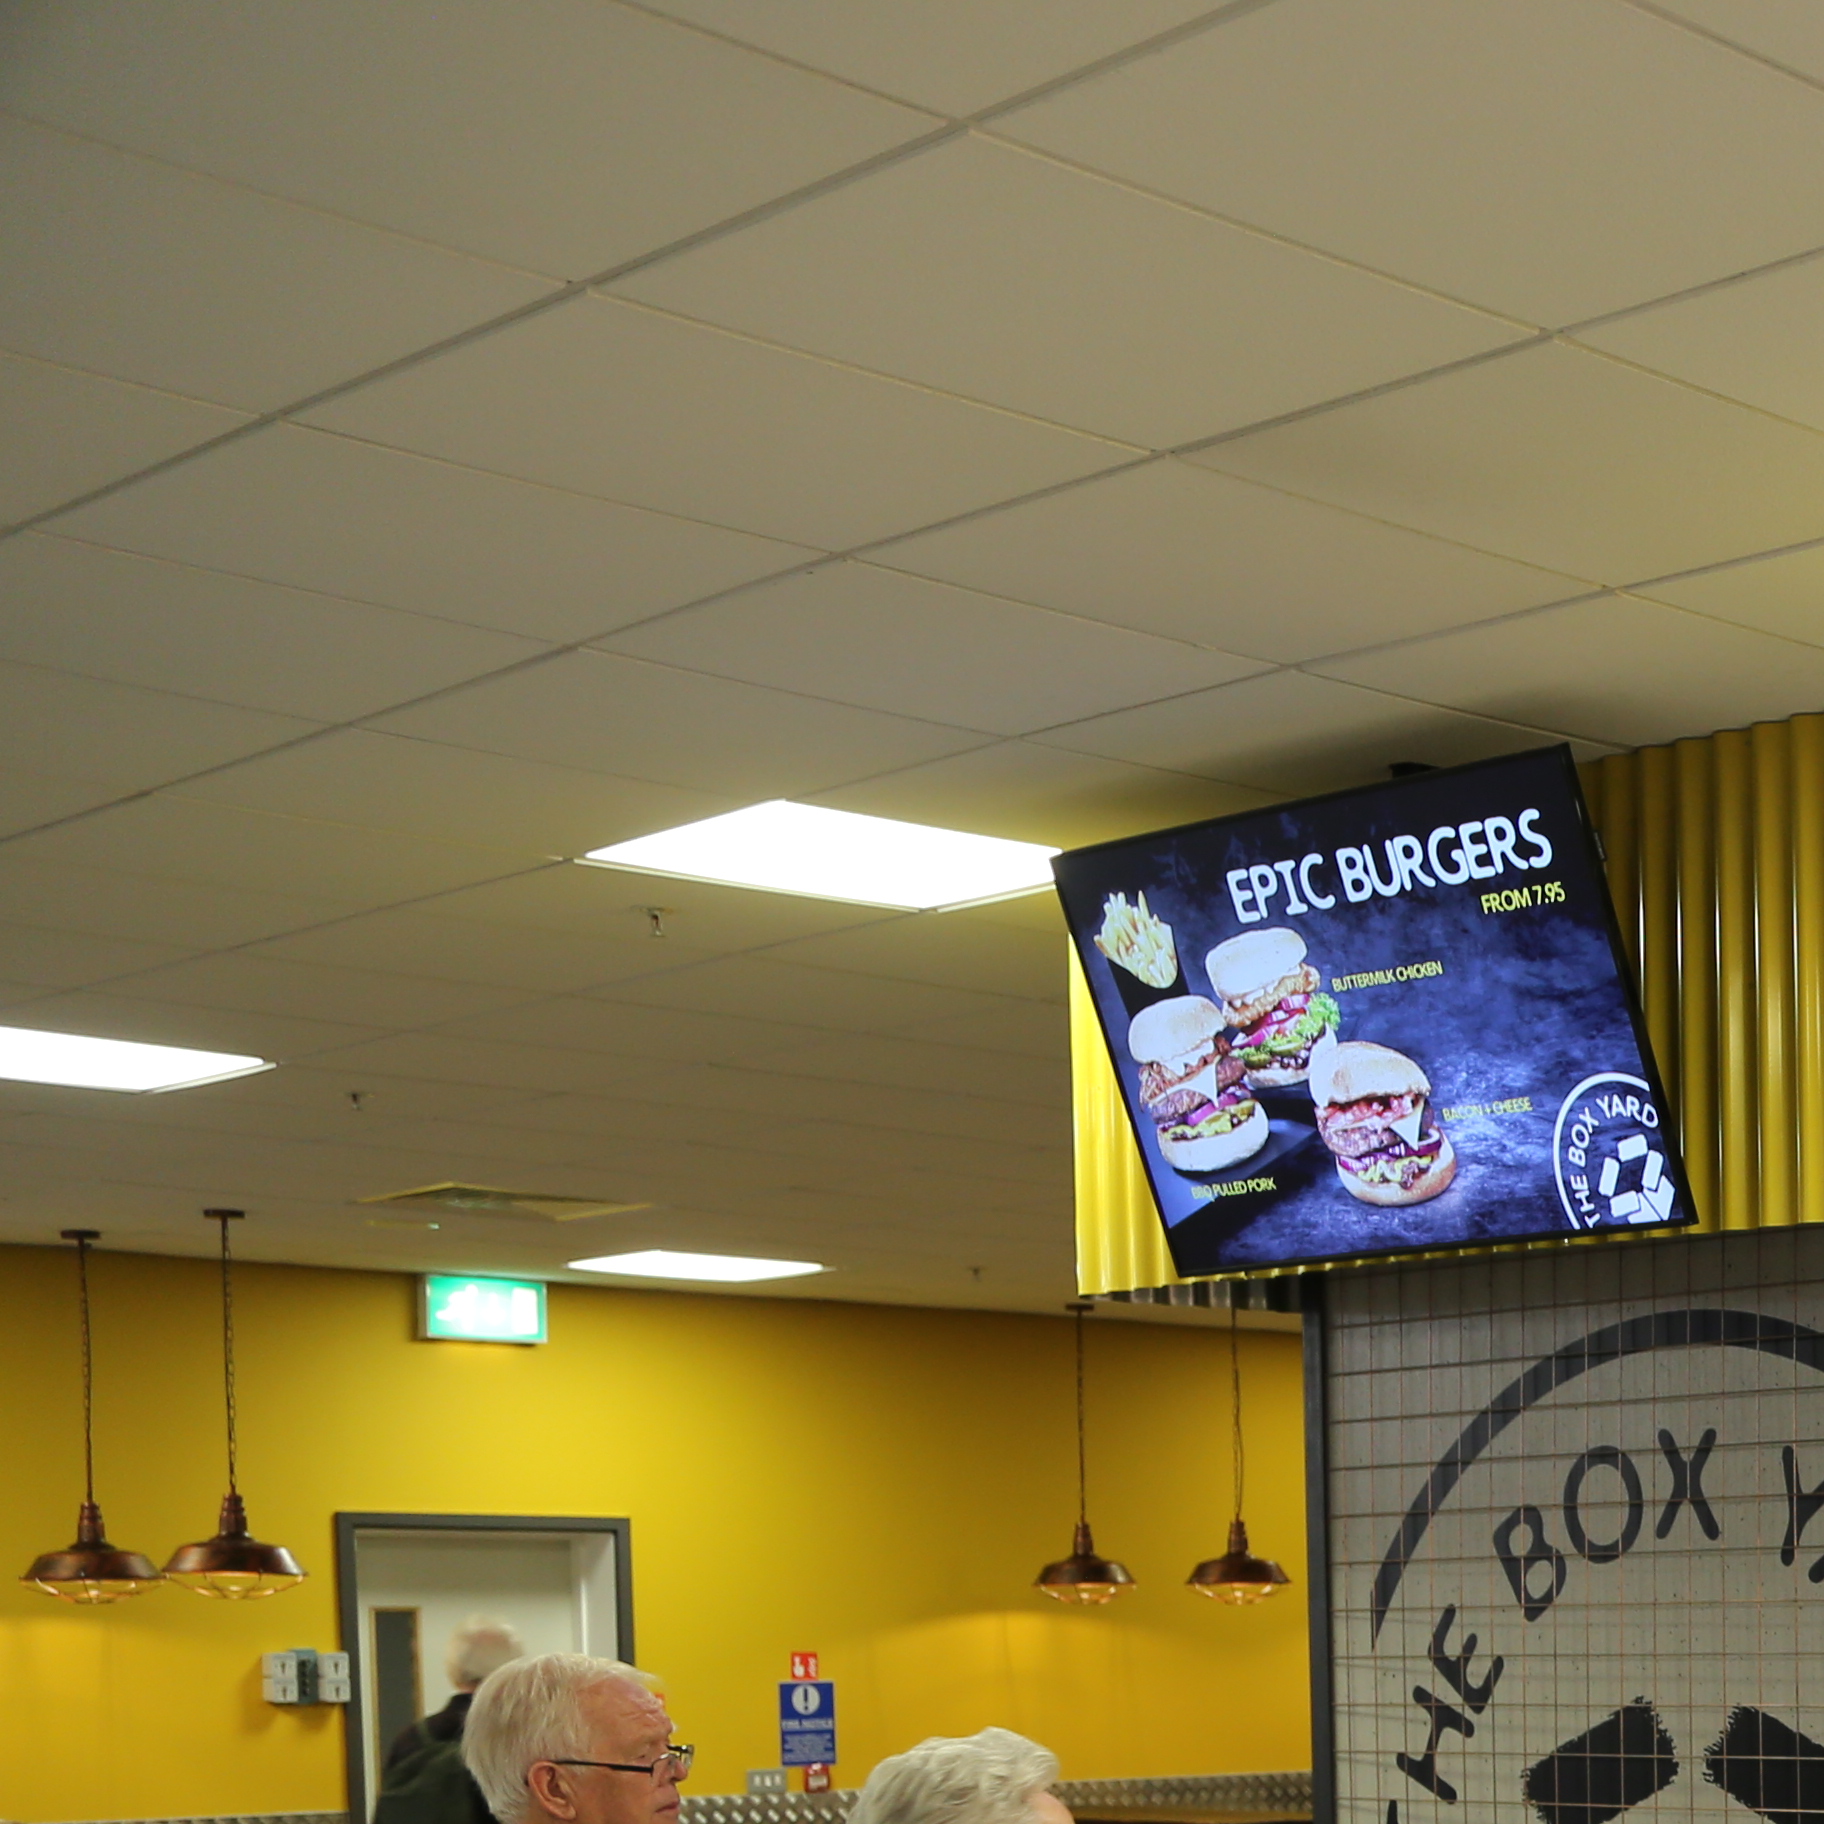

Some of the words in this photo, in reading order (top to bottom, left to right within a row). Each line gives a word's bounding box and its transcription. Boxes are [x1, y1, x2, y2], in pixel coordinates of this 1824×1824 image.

[1225, 853, 1335, 924] EPIC
[1334, 808, 1553, 904] BURGERS
[1481, 889, 1530, 915] FROM
[1531, 881, 1565, 906] 7.95
[1331, 967, 1395, 992] BUTTERMILK
[1395, 961, 1444, 982] CHICKEN
[1442, 1104, 1480, 1122] BACON
[1492, 1097, 1533, 1115] CHEESE
[1596, 1094, 1659, 1128] YARD
[1568, 1107, 1599, 1168] BOX
[1210, 1180, 1247, 1198] PULLED
[1247, 1177, 1277, 1192] PORK
[1570, 1174, 1600, 1228] THE
[1491, 1427, 1721, 1624] BOX
